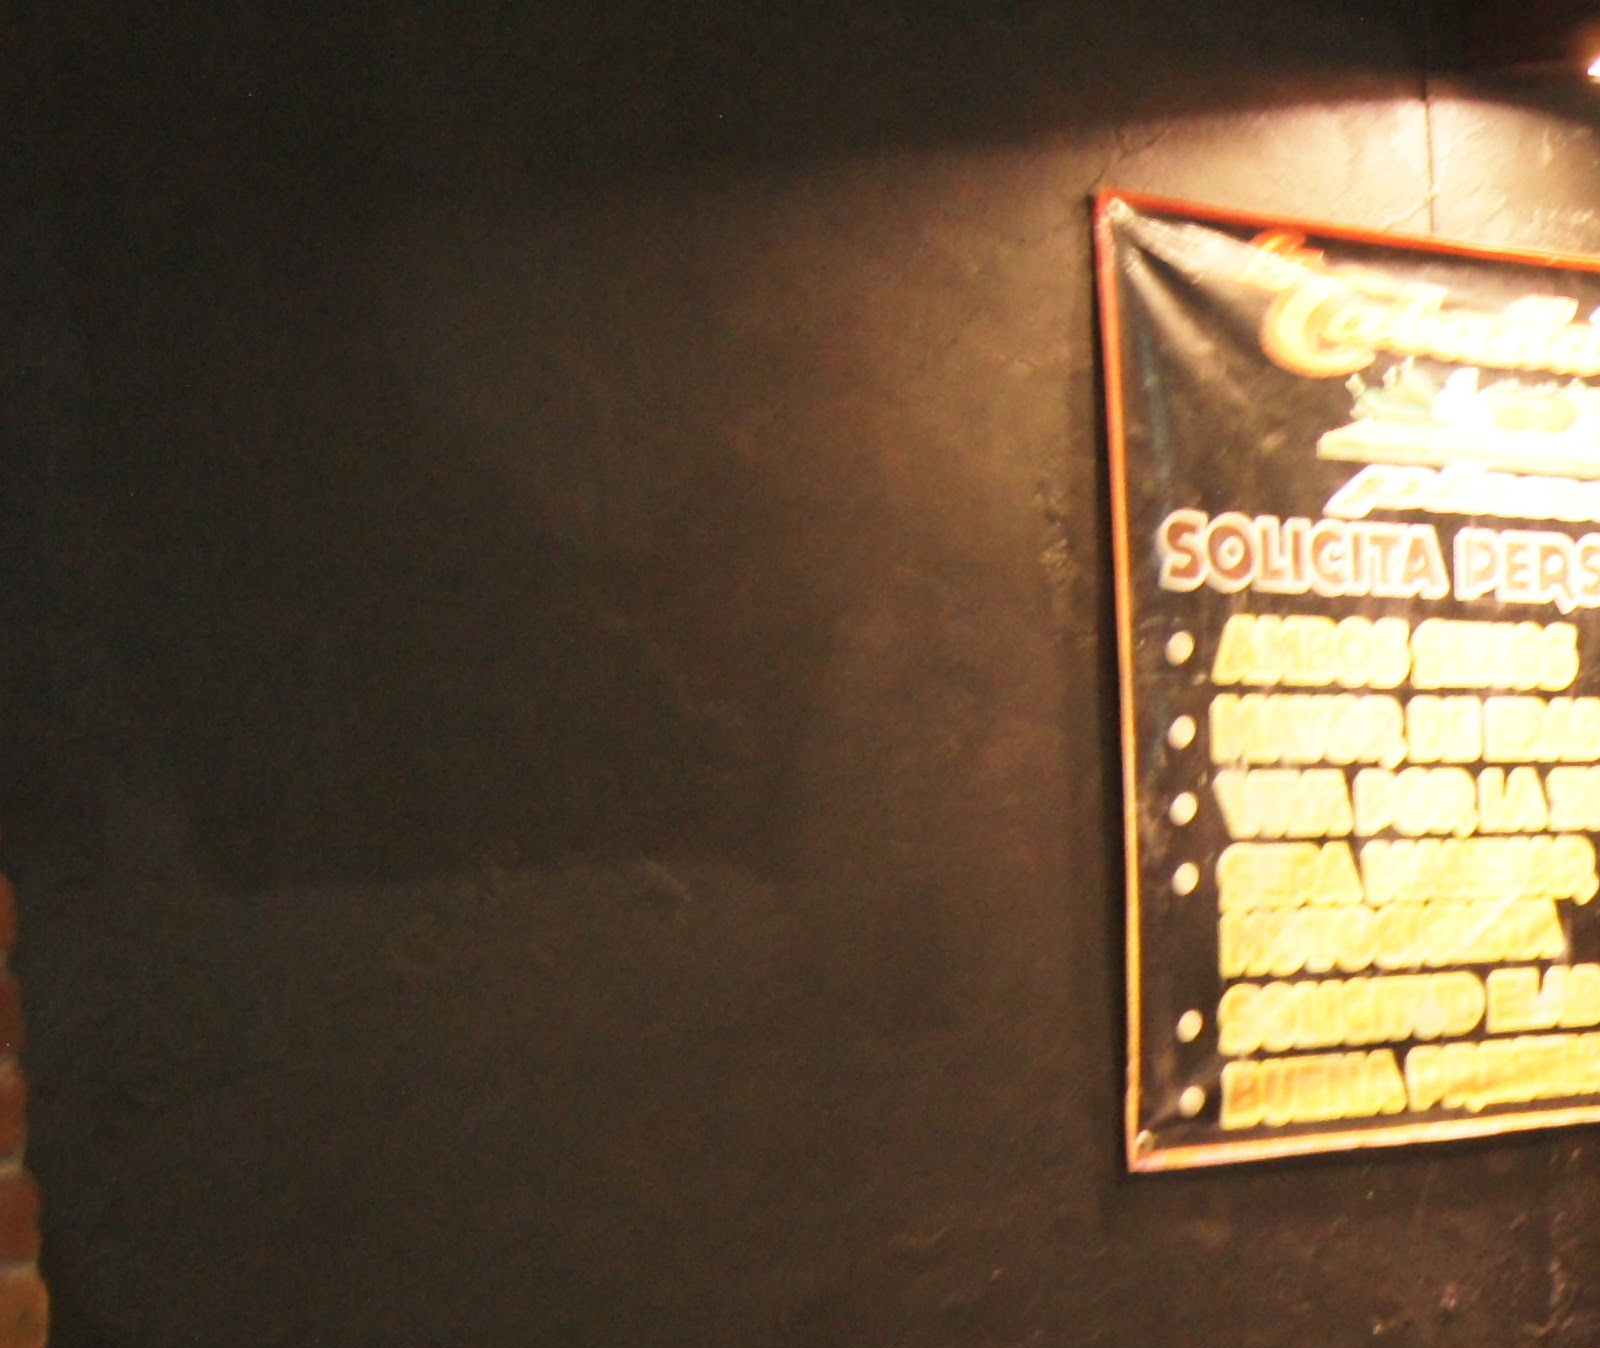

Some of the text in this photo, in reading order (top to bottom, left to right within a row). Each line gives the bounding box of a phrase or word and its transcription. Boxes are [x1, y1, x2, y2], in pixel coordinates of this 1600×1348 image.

[1159, 508, 1449, 600] SOLICITA
[1211, 612, 1411, 687] AMBOS
[1210, 694, 1407, 767] MAYOR
[1408, 697, 1482, 763] DE
[1480, 766, 1549, 833] LA
[1221, 1050, 1407, 1128] BUENA
